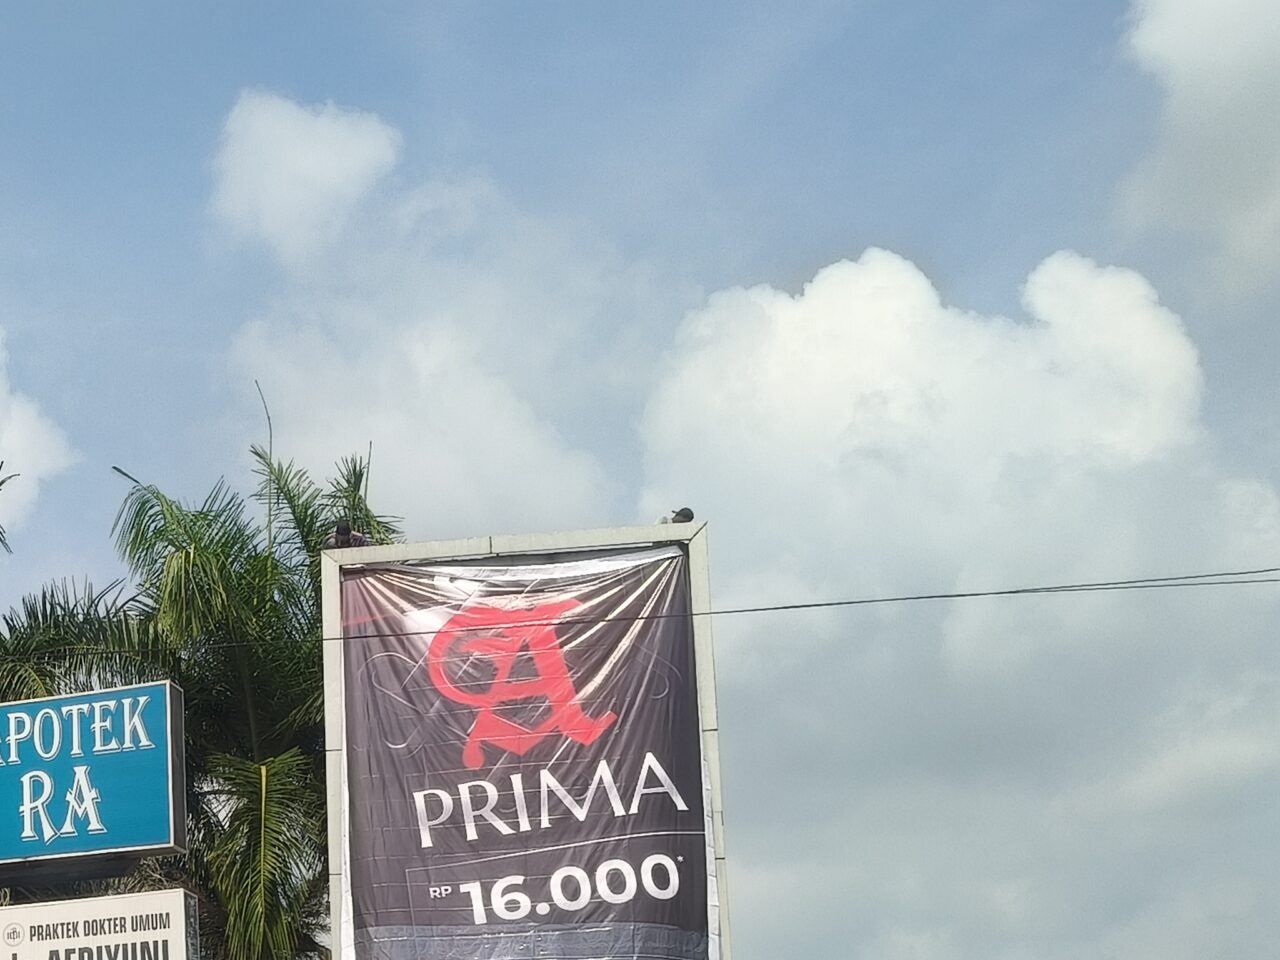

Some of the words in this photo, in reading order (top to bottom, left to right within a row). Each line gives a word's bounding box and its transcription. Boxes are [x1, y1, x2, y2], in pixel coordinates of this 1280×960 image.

[18, 765, 108, 846] RA
[412, 751, 689, 848] PRIMA
[429, 885, 452, 899] RP
[29, 921, 80, 942] PRAKTEK
[83, 916, 127, 936] DOKTER
[131, 912, 171, 933] UMUM
